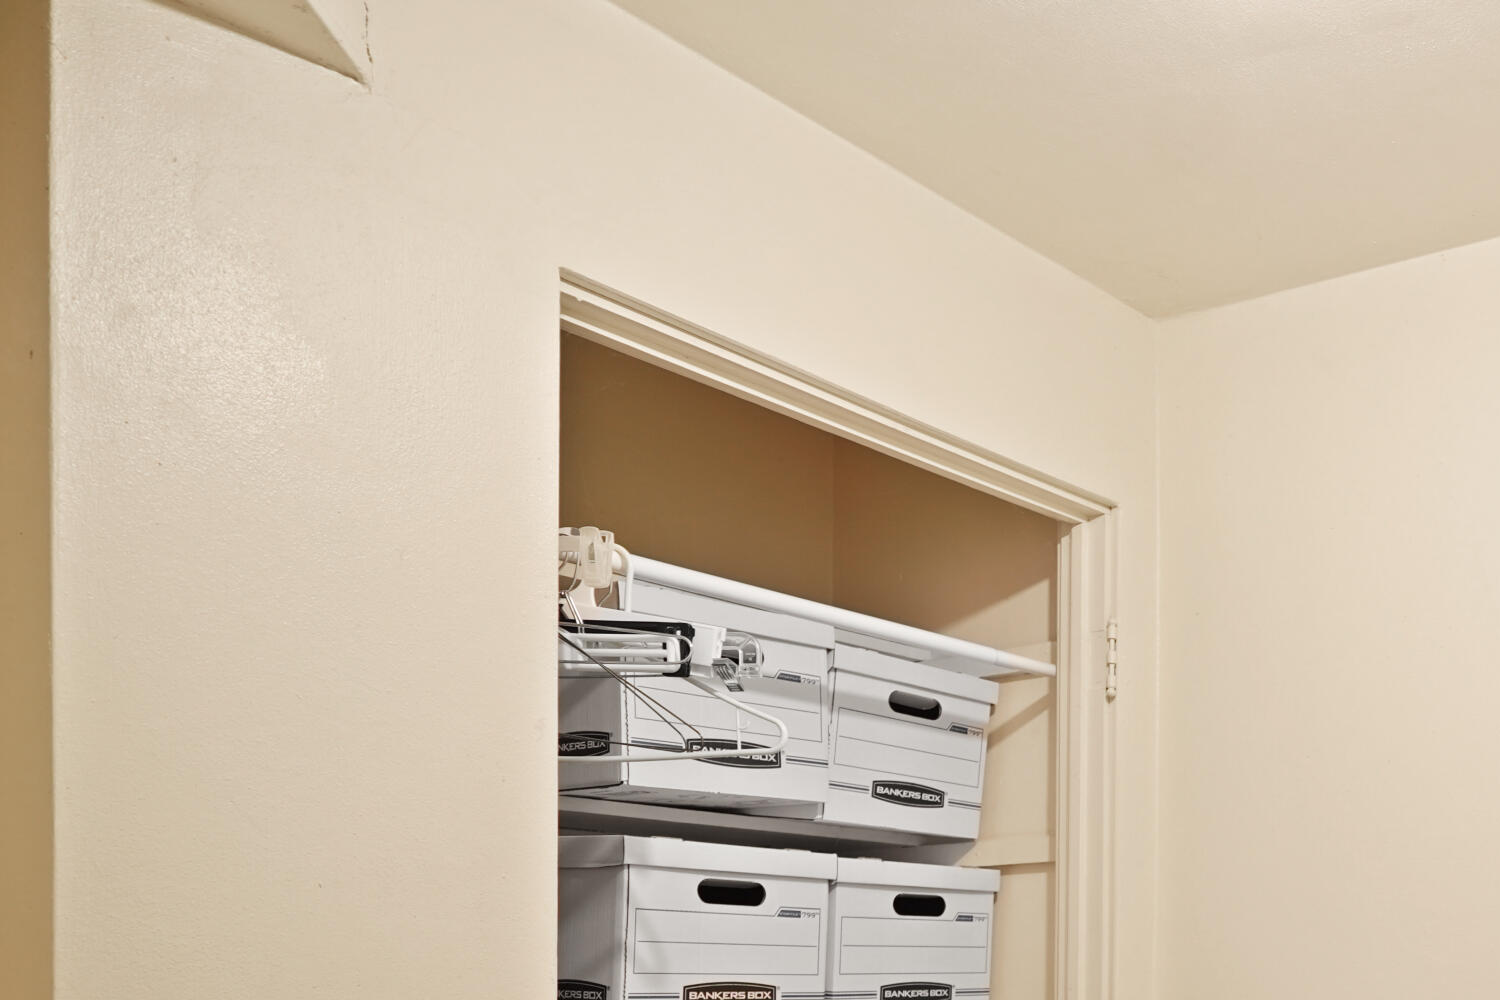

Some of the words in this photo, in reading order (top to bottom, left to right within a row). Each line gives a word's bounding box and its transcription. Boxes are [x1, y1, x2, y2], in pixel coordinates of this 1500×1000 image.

[876, 786, 921, 800] BANKERS
[921, 793, 942, 803] BOX
[558, 991, 582, 999] KERS
[583, 991, 602, 1000] BOX
[688, 991, 746, 1000] BANKERS
[747, 991, 772, 1000] BOX
[884, 989, 929, 998] BANKERS
[930, 988, 949, 997] BOX
